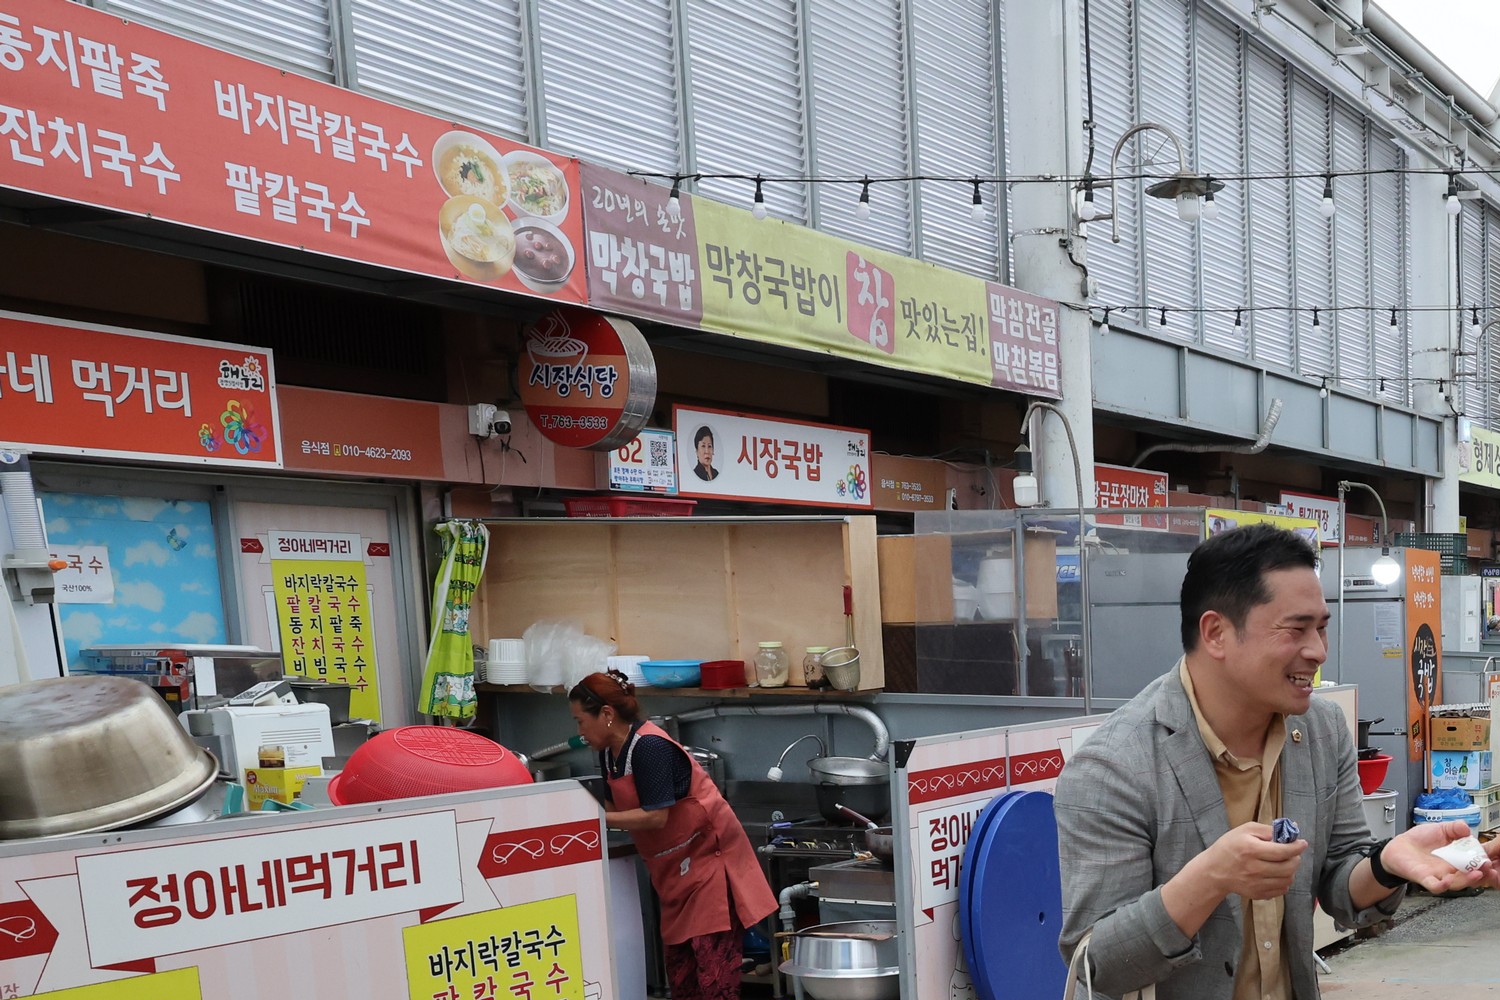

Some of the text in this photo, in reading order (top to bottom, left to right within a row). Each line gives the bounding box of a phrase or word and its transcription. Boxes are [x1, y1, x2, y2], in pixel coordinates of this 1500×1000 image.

[0, 17, 423, 178] 동지팥죽 바지락칼국수
[0, 106, 371, 238] 잔치국수 팥칼국수
[592, 185, 649, 226] 20년의
[590, 230, 695, 311] 막창국밥
[705, 243, 841, 323] 막창국밥이
[0, 351, 192, 418] 네 먹거리
[529, 364, 618, 398] 시장식당
[540, 415, 608, 429] T.763-3533
[301, 440, 411, 460] 음식점 010-4623-2093
[737, 435, 823, 482] 시장국밥
[278, 538, 351, 554] 정아네먹거리
[62, 584, 92, 592] 국산100%
[284, 574, 358, 593] 바지락칼국수
[930, 808, 983, 852] 정아
[126, 839, 422, 930] 정아네먹거리
[428, 925, 566, 982] 바지락칼국수
